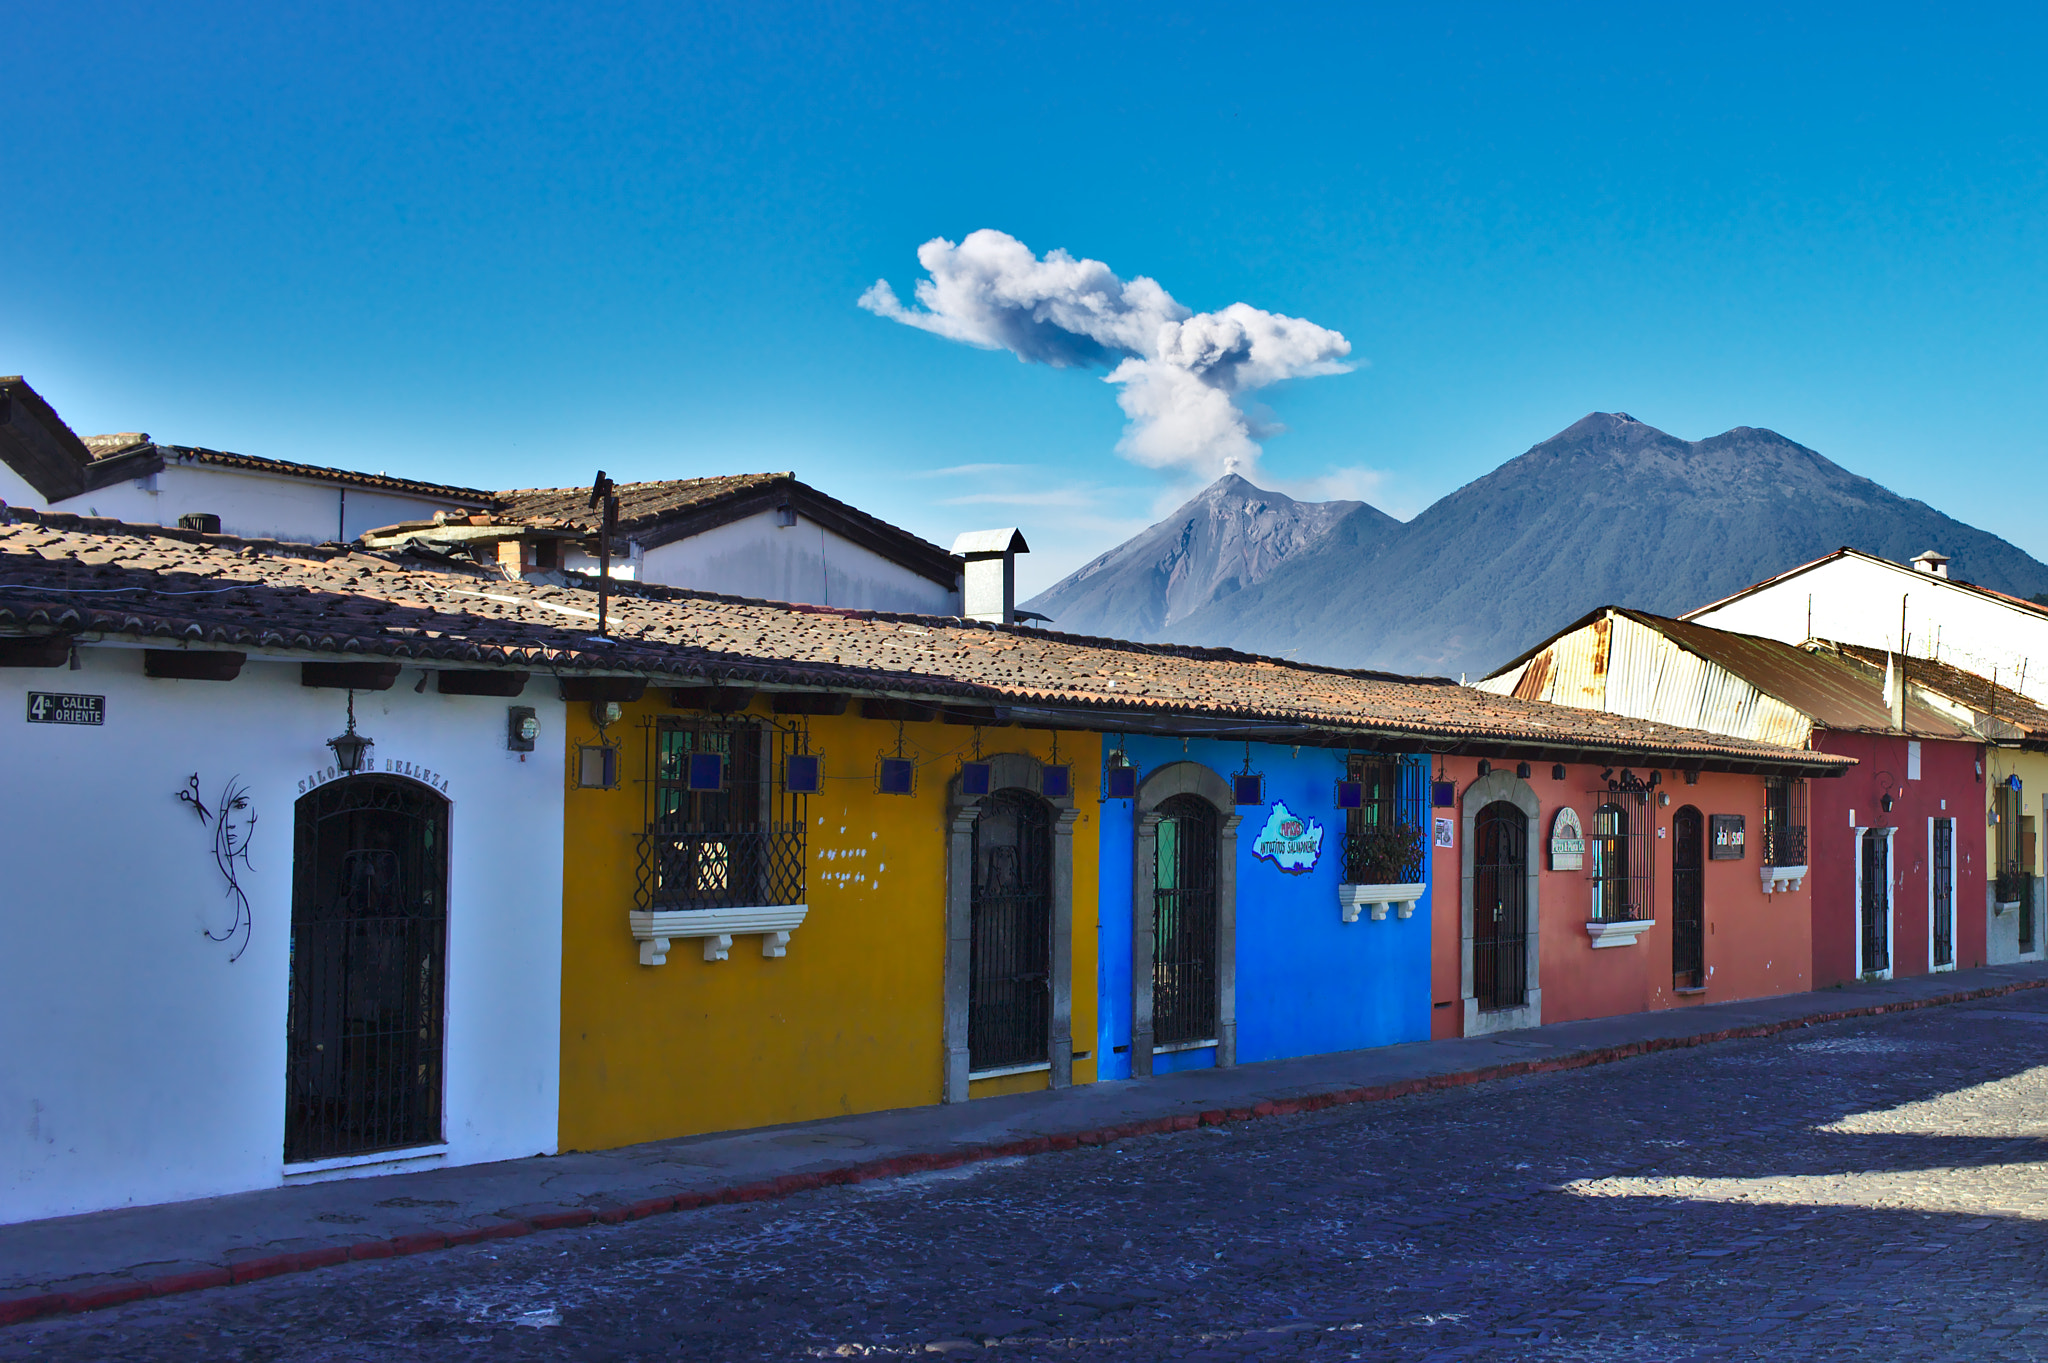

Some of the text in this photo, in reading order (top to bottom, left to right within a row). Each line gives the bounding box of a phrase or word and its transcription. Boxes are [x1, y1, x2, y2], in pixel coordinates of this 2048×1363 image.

[32, 696, 96, 720] 4a. CALLE
[56, 709, 101, 722] ORIENTE
[359, 758, 375, 772] DE
[386, 758, 449, 793] BELLEZA
